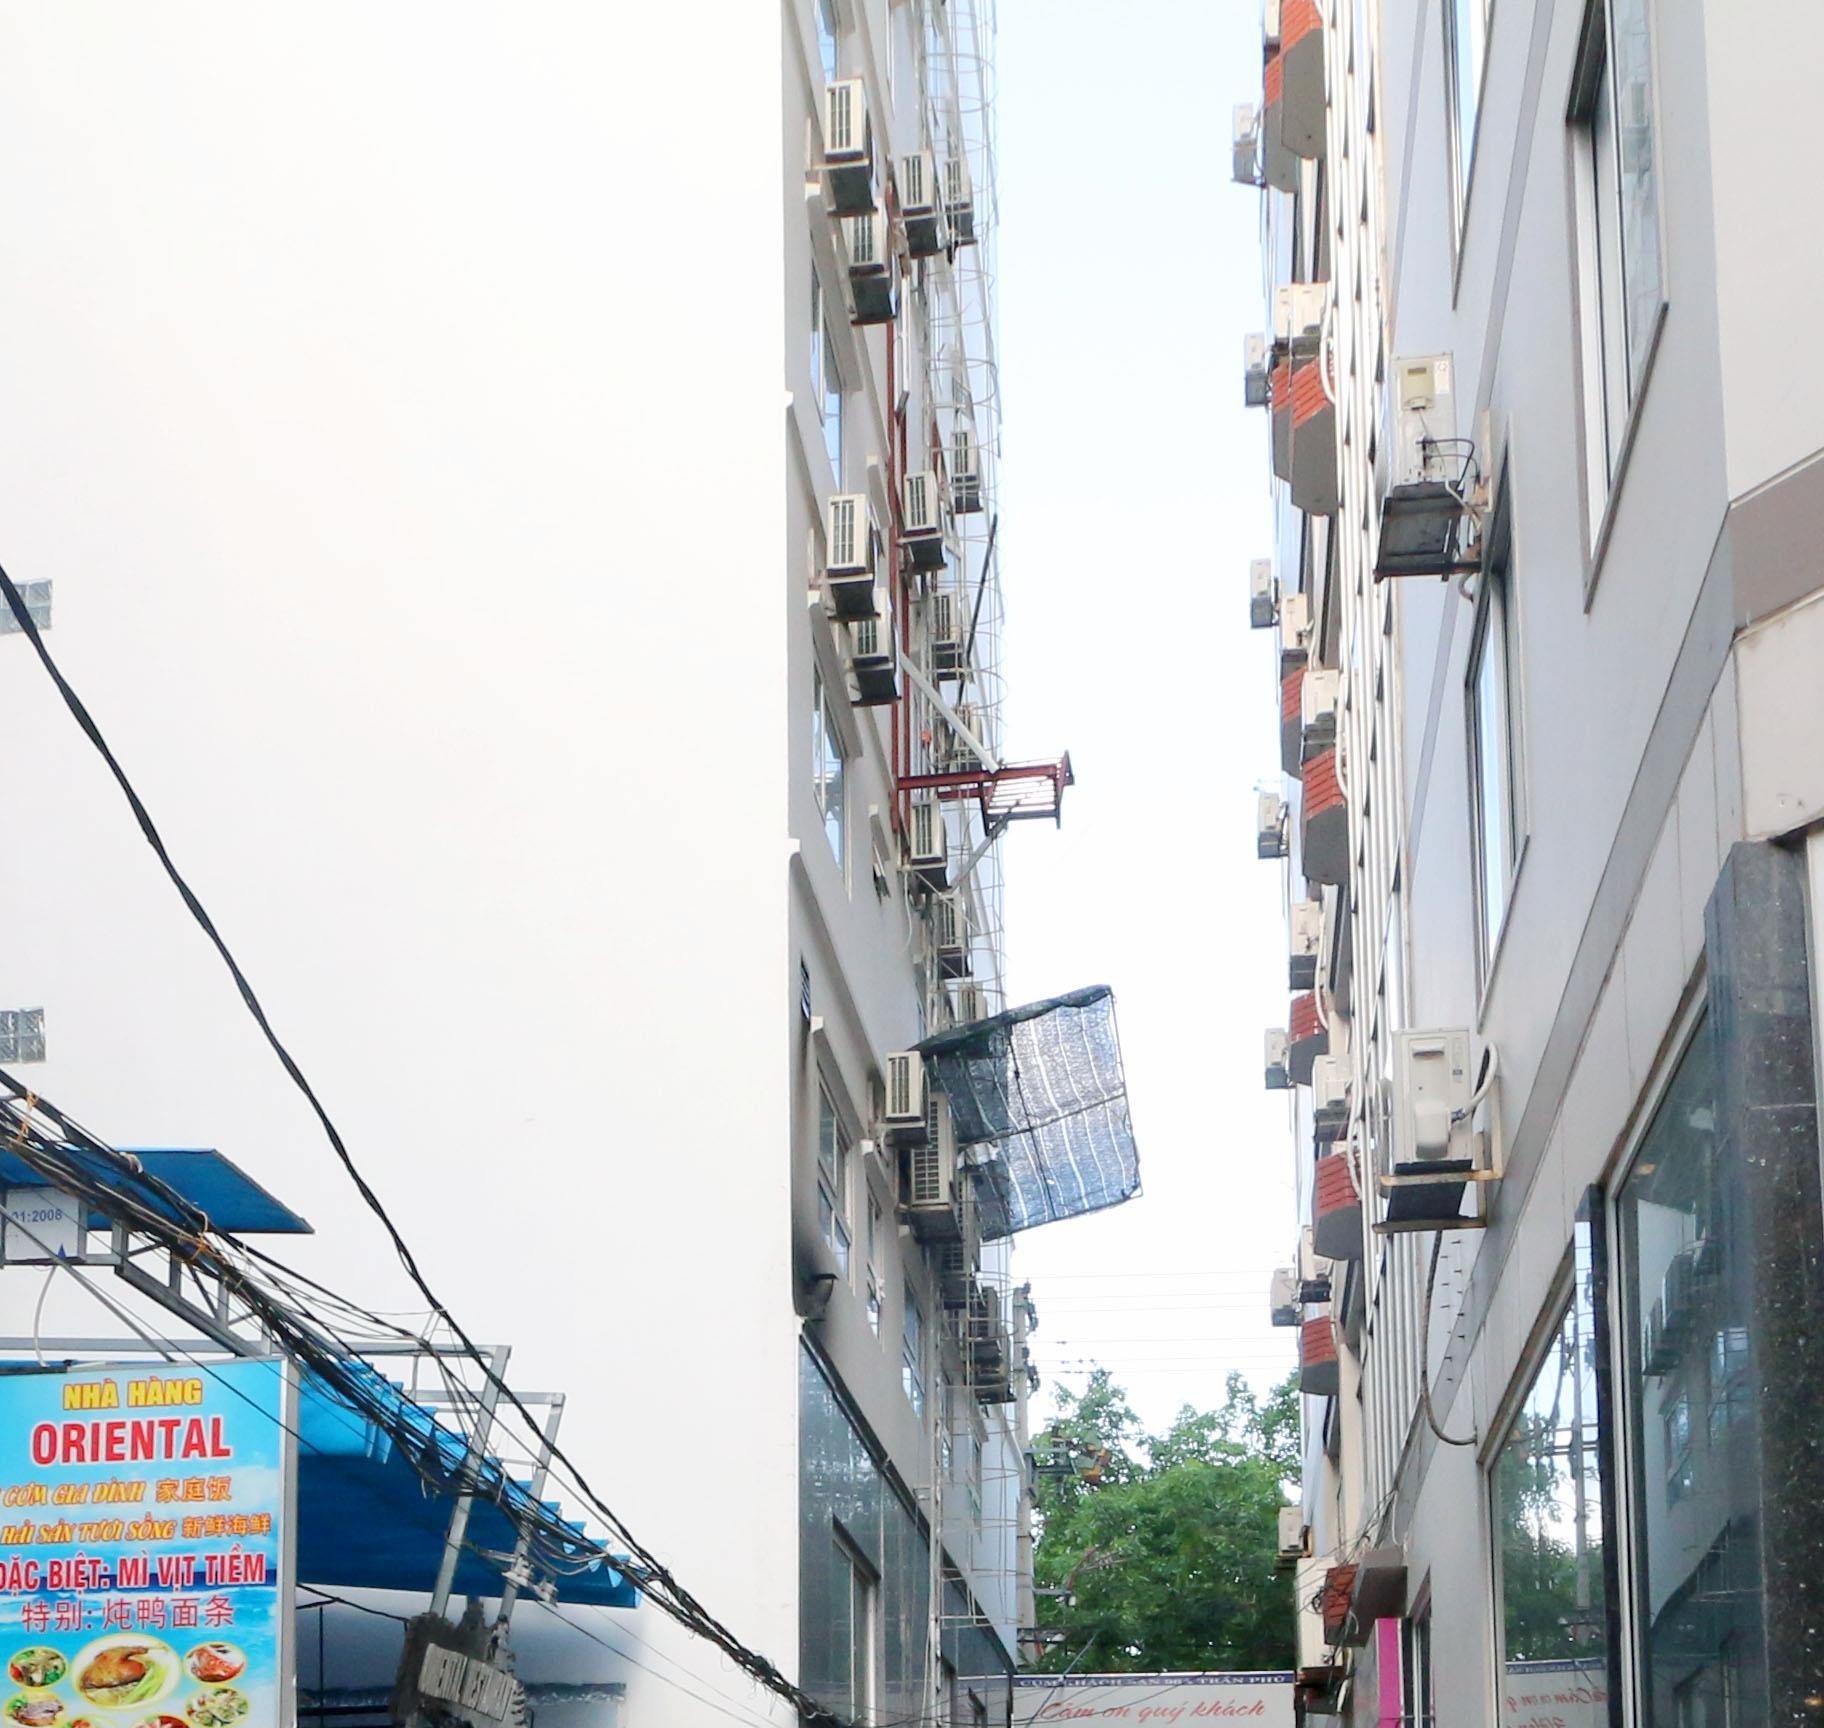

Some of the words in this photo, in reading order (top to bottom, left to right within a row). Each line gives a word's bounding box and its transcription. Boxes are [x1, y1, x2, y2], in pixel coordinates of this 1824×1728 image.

[62, 1378, 119, 1410] NHÀ
[127, 1376, 203, 1408] HÀNG
[31, 1416, 231, 1466] ORIENTAL
[47, 1552, 110, 1597] BIỆT:
[117, 1549, 151, 1589] MÌ
[157, 1554, 197, 1593] VỊT
[204, 1543, 267, 1586] TIỀM
[1138, 1701, 1190, 1725] quý
[1190, 1699, 1265, 1718] khách
